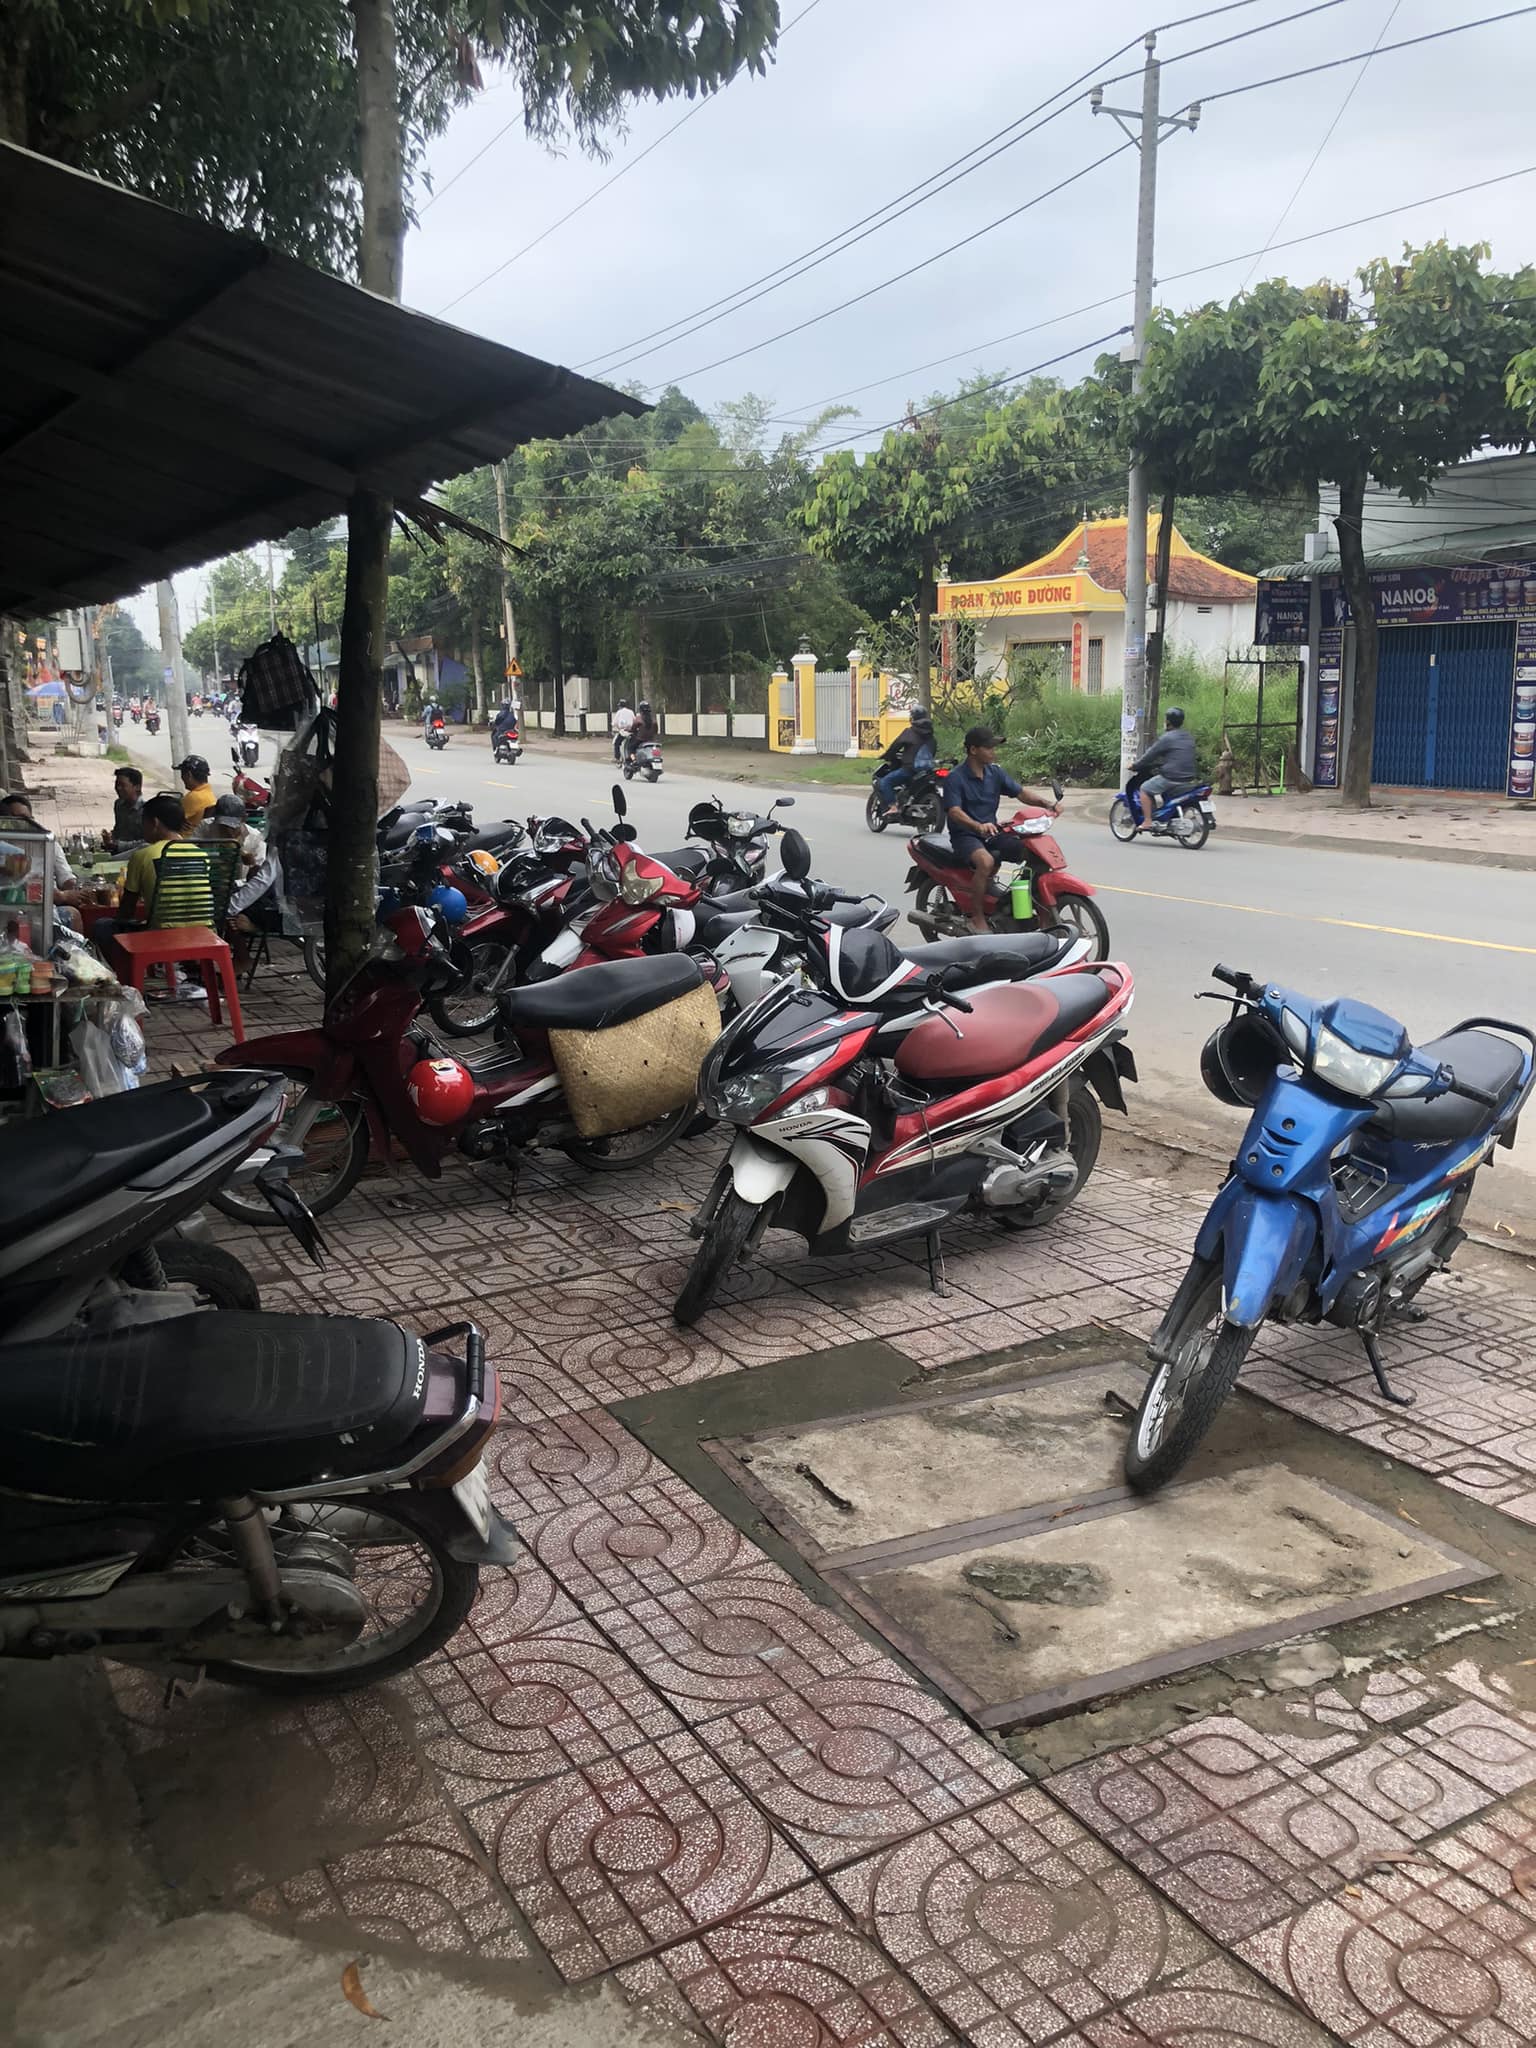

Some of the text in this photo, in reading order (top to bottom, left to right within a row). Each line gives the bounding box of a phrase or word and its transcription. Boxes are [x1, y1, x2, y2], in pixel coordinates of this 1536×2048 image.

[1028, 584, 1072, 604] ĐƯỜNG
[1381, 587, 1436, 606] NANO8
[779, 1121, 813, 1132] HONDA
[412, 1338, 426, 1400] HONDA
